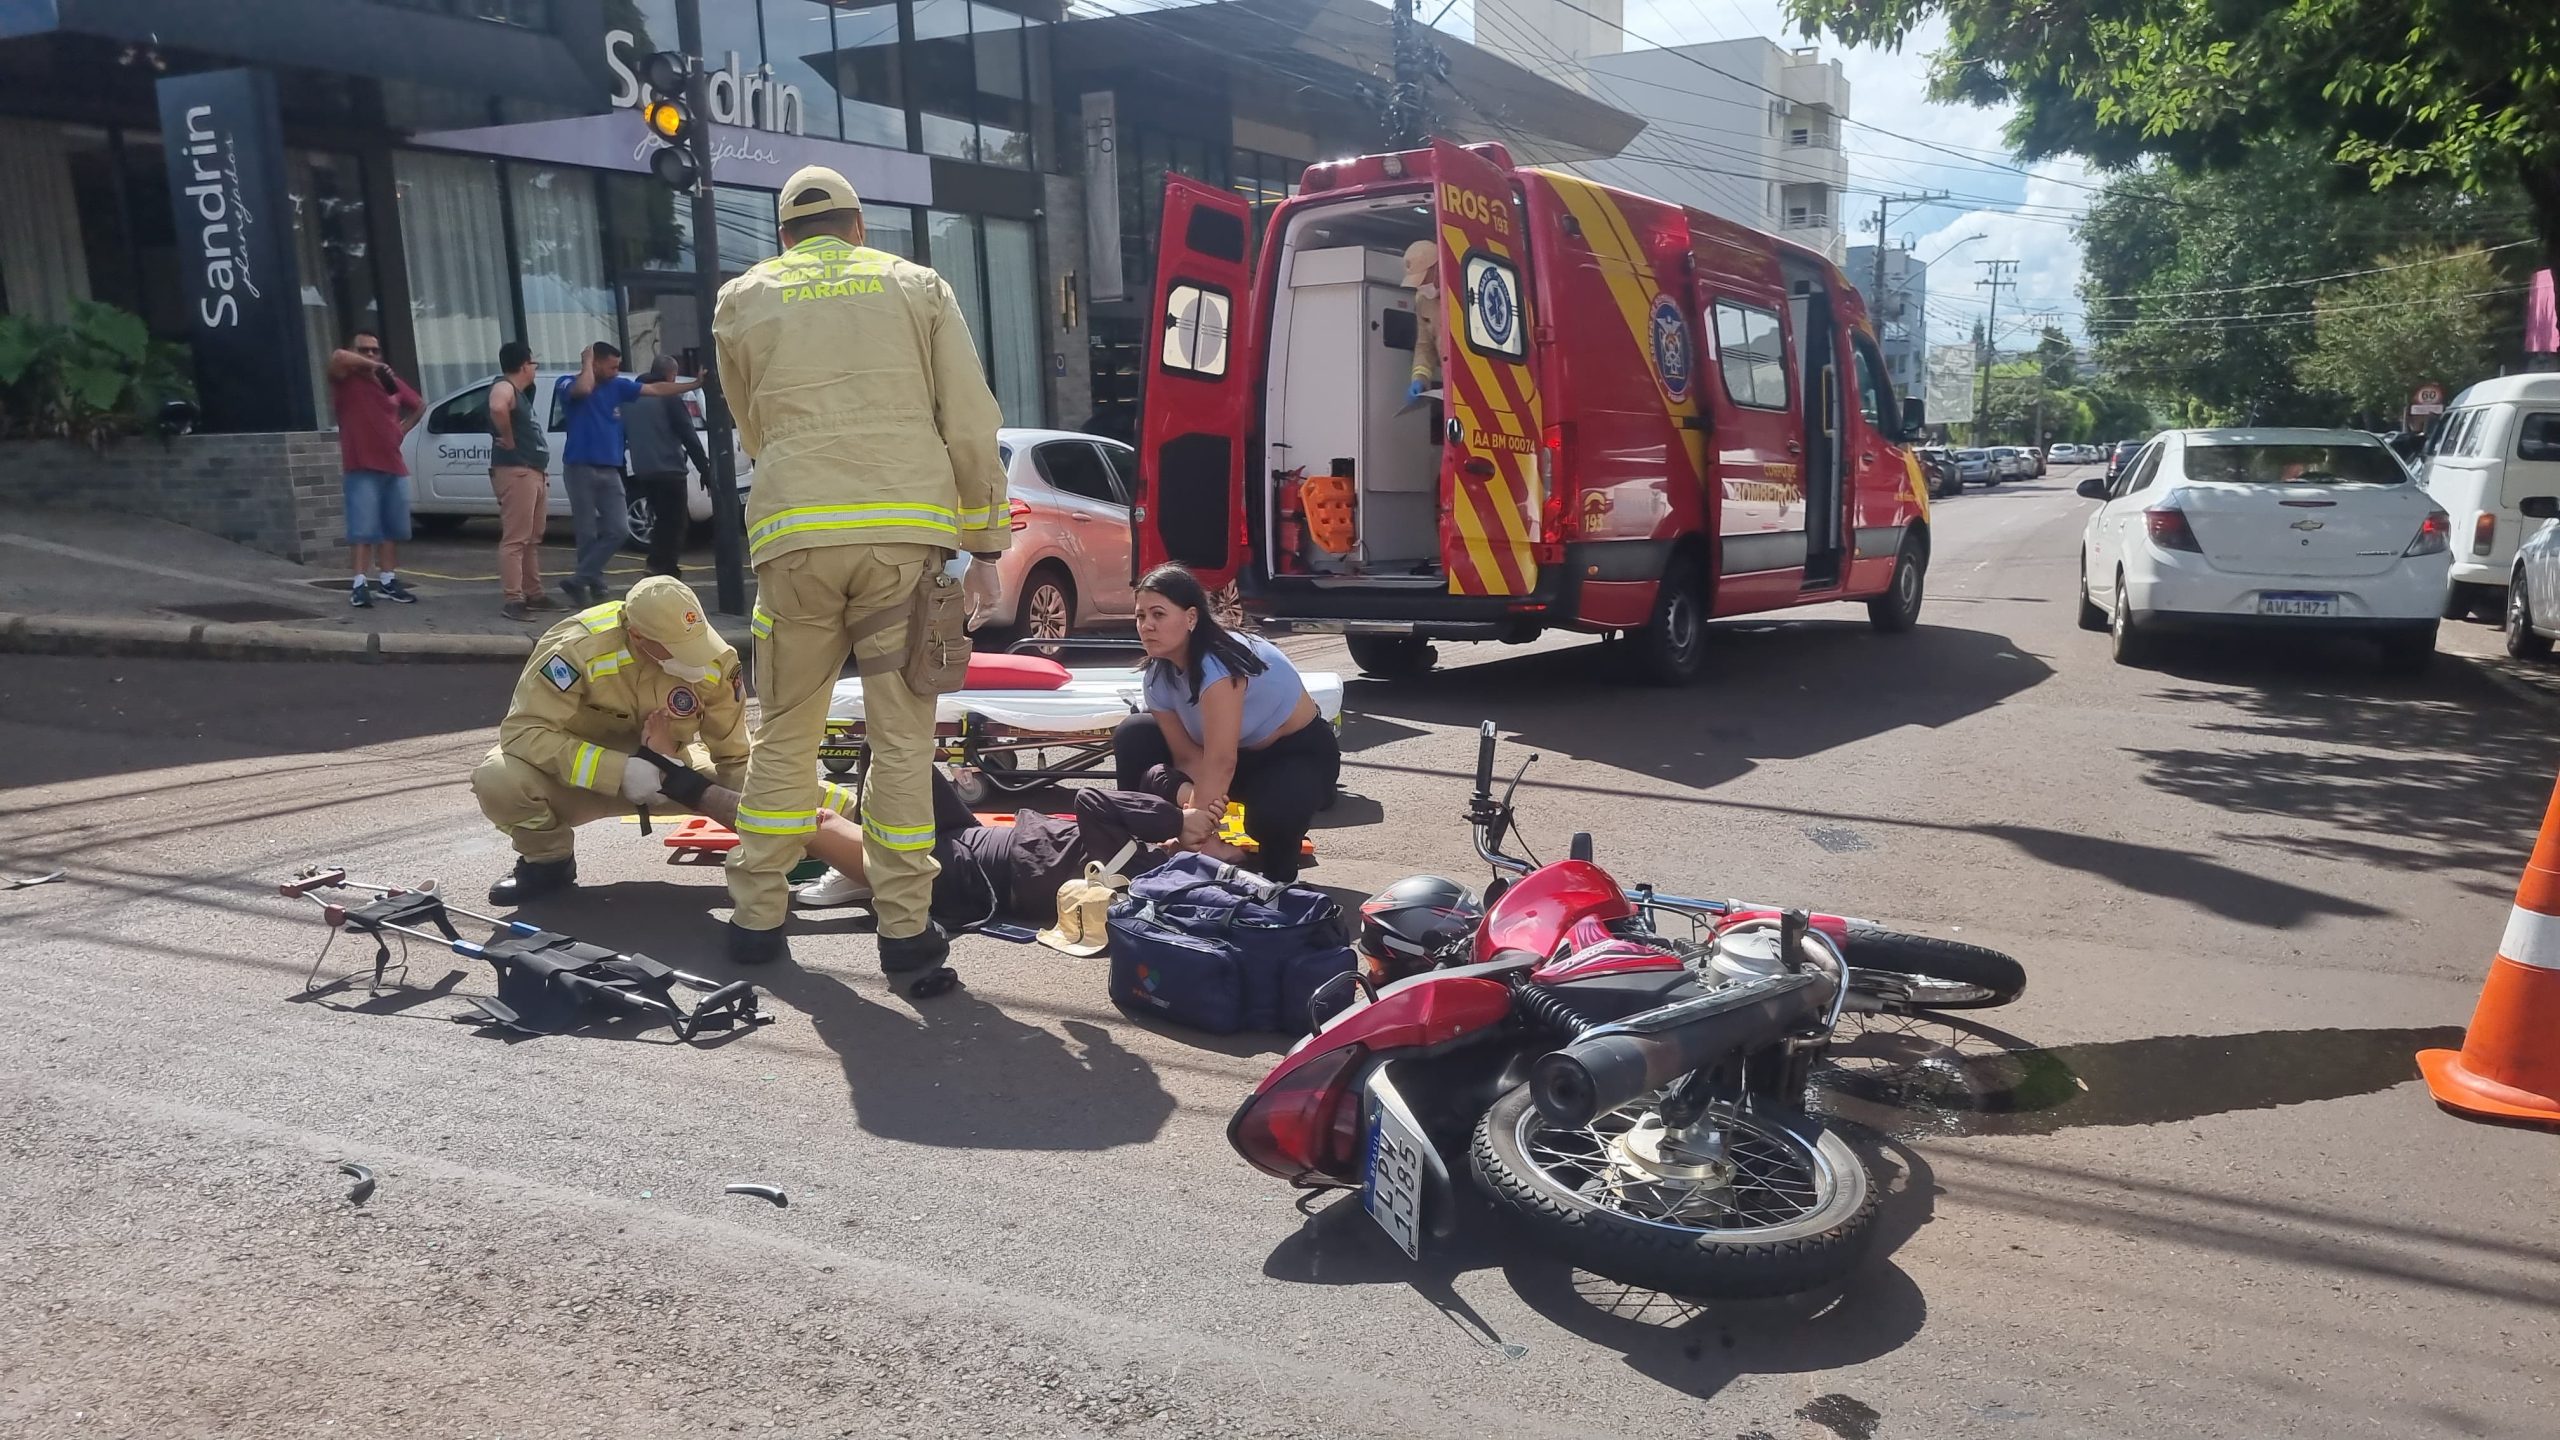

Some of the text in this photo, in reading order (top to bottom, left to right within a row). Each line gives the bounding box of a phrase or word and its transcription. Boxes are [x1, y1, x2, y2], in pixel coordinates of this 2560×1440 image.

[604, 29, 804, 136] Sdrin
[182, 104, 238, 328] Sandrin
[224, 132, 260, 298] planejados
[1440, 182, 1490, 225] IROS
[782, 275, 885, 304] PARANÁ
[2421, 390, 2437, 401] 60
[438, 444, 492, 459] Sandri
[1474, 431, 1490, 447] AA
[1492, 433, 1507, 449] BM
[1584, 513, 1604, 533] 193
[1370, 1135, 1380, 1177] BRASIL
[1394, 1137, 1417, 1241] 1J85
